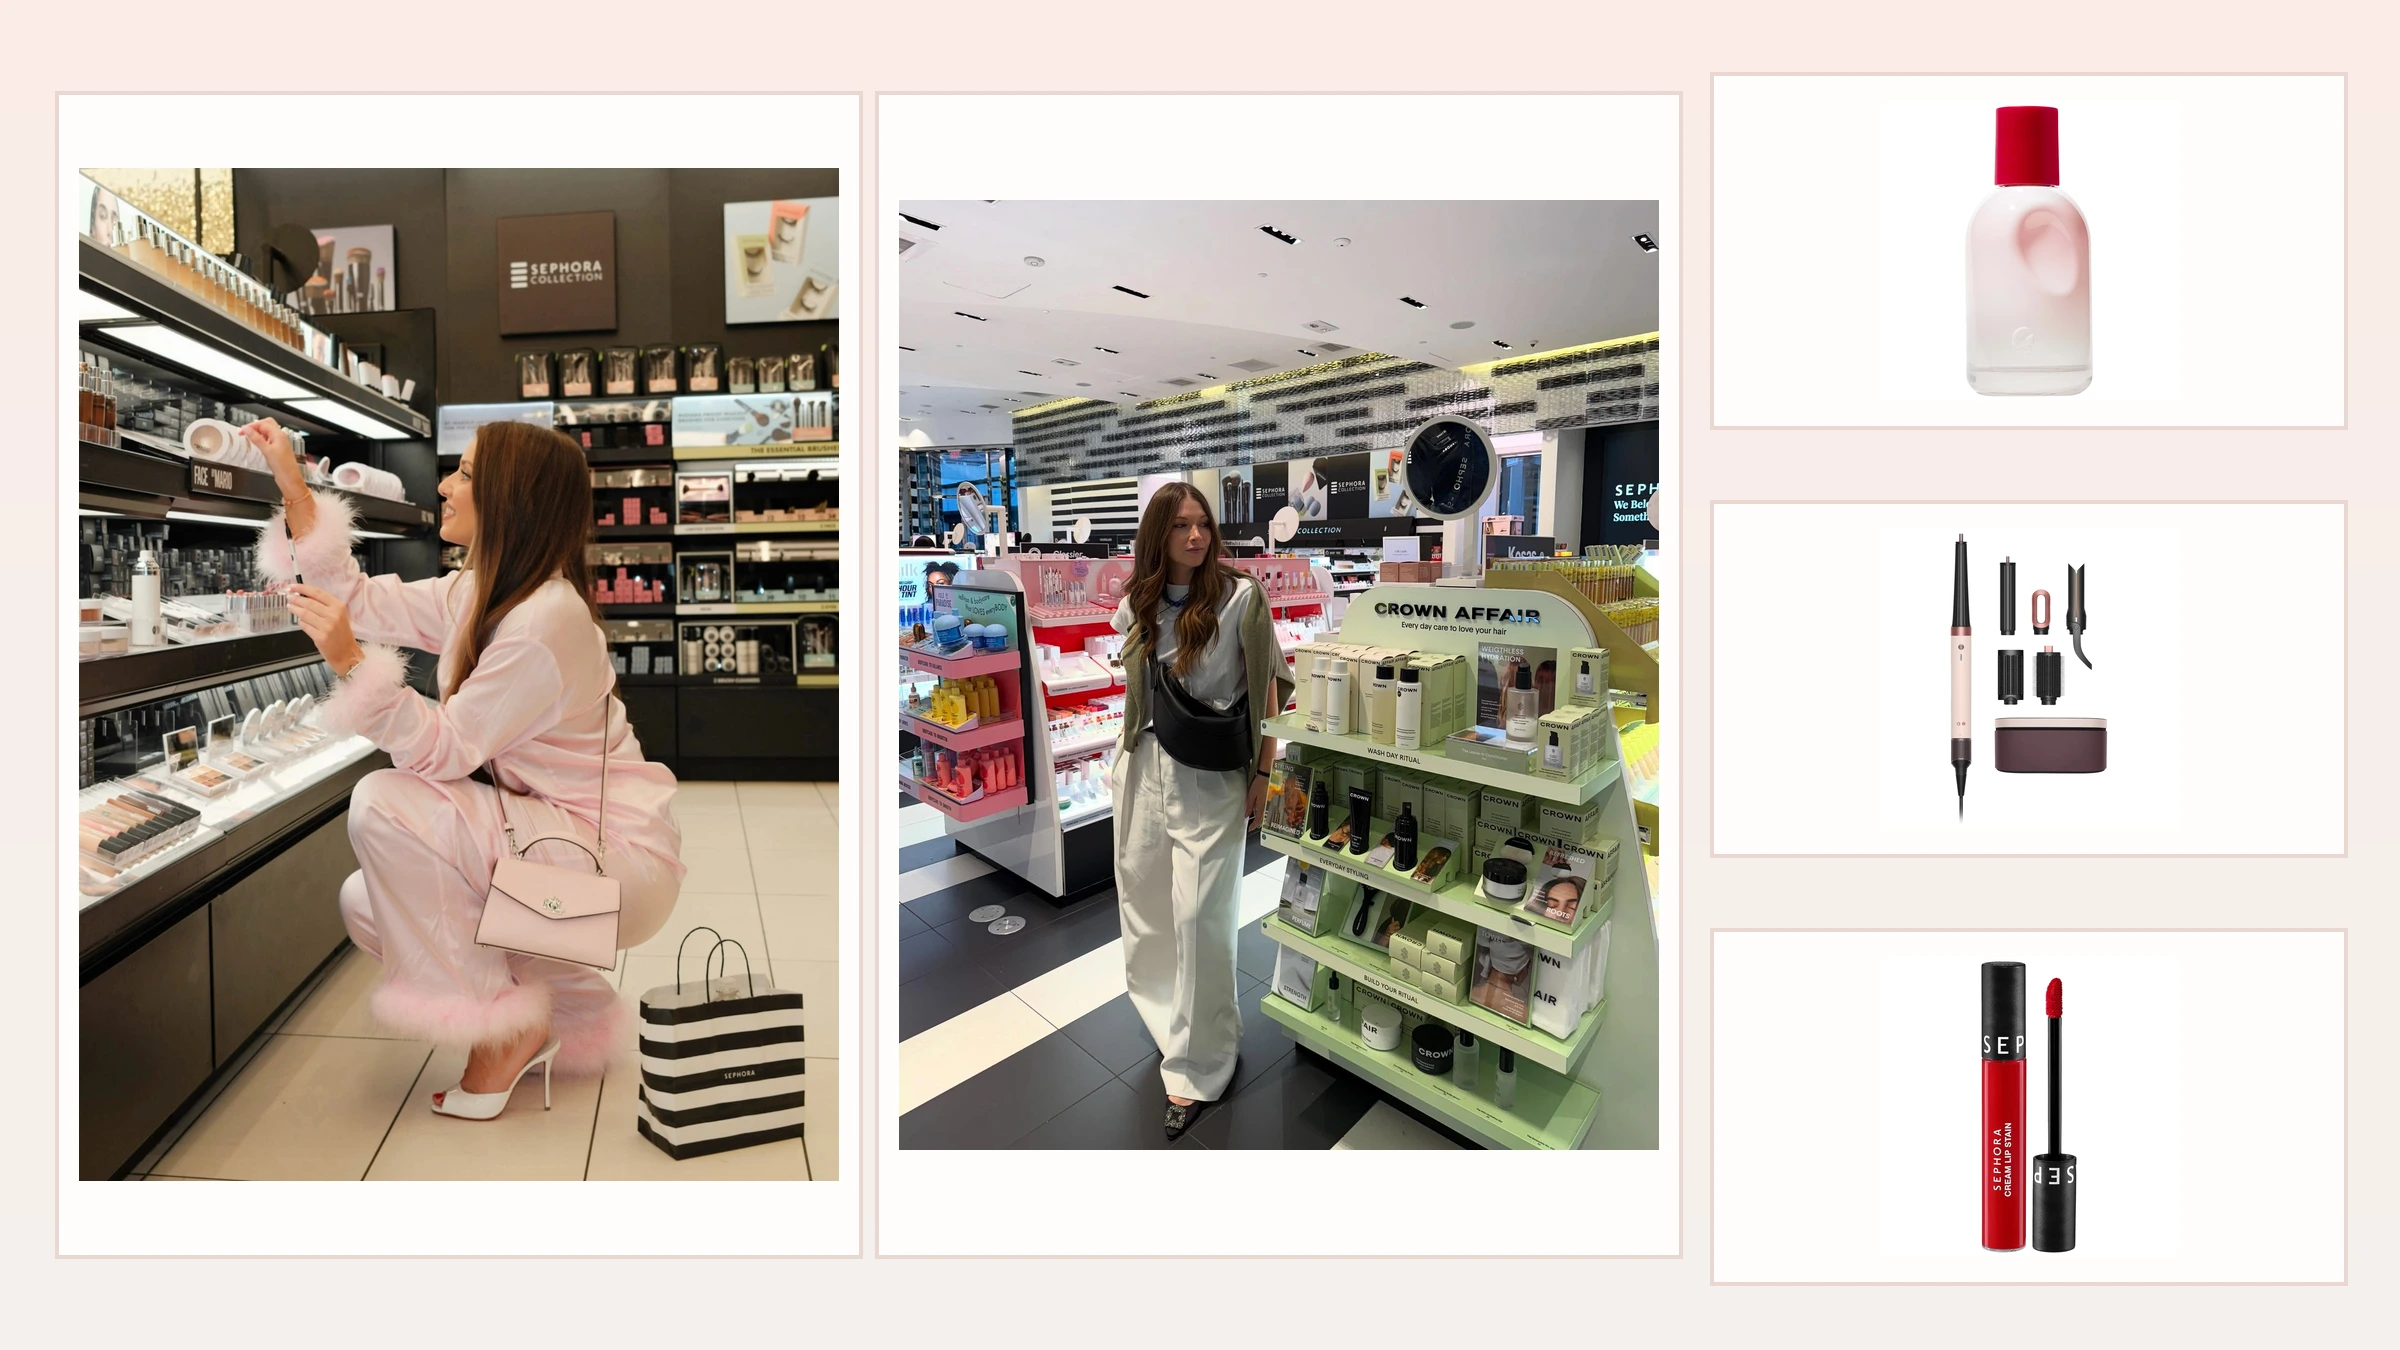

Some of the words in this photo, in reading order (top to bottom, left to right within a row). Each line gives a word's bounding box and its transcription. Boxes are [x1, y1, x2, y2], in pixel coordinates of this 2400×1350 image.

[531, 260, 602, 275] SEPHORA
[530, 273, 602, 284] COLLECTION
[194, 466, 208, 486] FACE
[1614, 501, 1628, 509] We
[973, 606, 985, 615] LOVES
[1374, 603, 1446, 618] CROWN
[1455, 606, 1541, 624] AFFAIR
[1420, 622, 1432, 631] day
[1475, 628, 1491, 636] your
[1540, 722, 1569, 730] CROWN
[1367, 748, 1385, 756] WASH
[1400, 755, 1421, 764] RITUAL
[1274, 763, 1294, 771] STYLING
[1402, 782, 1420, 790] CROWN
[1425, 787, 1443, 795] CROWN
[1349, 792, 1369, 801] CROWN
[1446, 794, 1466, 802] CROWN
[1483, 795, 1519, 808] CROWN
[1542, 809, 1582, 823] CROWN
[1271, 822, 1300, 835] REIMAGINED
[1477, 821, 1513, 835] CROWN
[1518, 831, 1556, 846] CROWN
[1549, 850, 1585, 864] REFRESHED
[1563, 843, 1605, 860] CROWN
[1319, 858, 1345, 872] EVERYDAY
[1346, 868, 1369, 880] STYLING
[1546, 907, 1571, 919] ROOTS
[1292, 916, 1312, 929] PERFUME
[1396, 933, 1422, 947] CROWN
[1283, 985, 1307, 1001] STRENGTH
[1356, 985, 1387, 1005] CROWN
[1364, 975, 1380, 987] BUILD
[1381, 982, 1397, 995] YOUR
[1398, 990, 1419, 1004] RITUAL
[1390, 1003, 1423, 1021] CROWN
[1984, 1035, 2025, 1054] SEP
[1418, 1047, 1453, 1059] CROWN
[724, 1069, 756, 1080] SEPHORA
[2004, 1122, 2012, 1146] STAIN
[1993, 1128, 2002, 1191] SEPHORA
